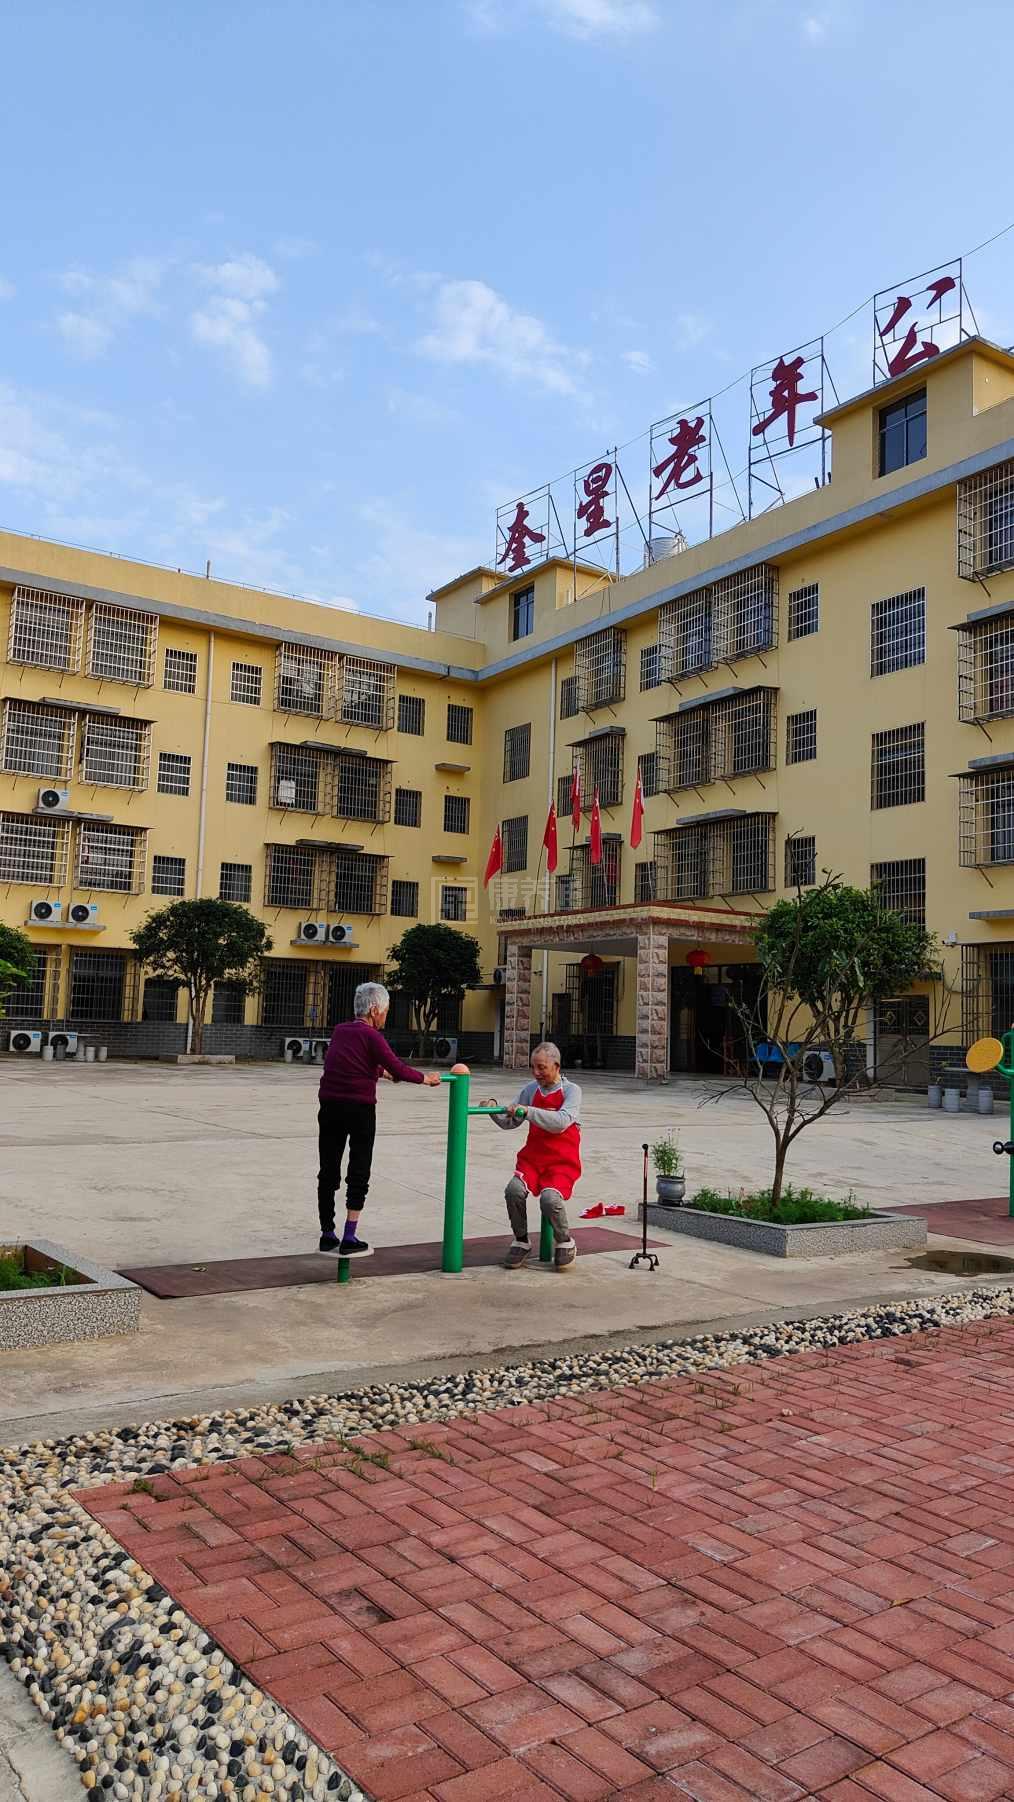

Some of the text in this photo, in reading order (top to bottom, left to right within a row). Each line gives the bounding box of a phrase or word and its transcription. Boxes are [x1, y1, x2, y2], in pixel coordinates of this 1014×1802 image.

[498, 276, 956, 572] 奎星老年公
